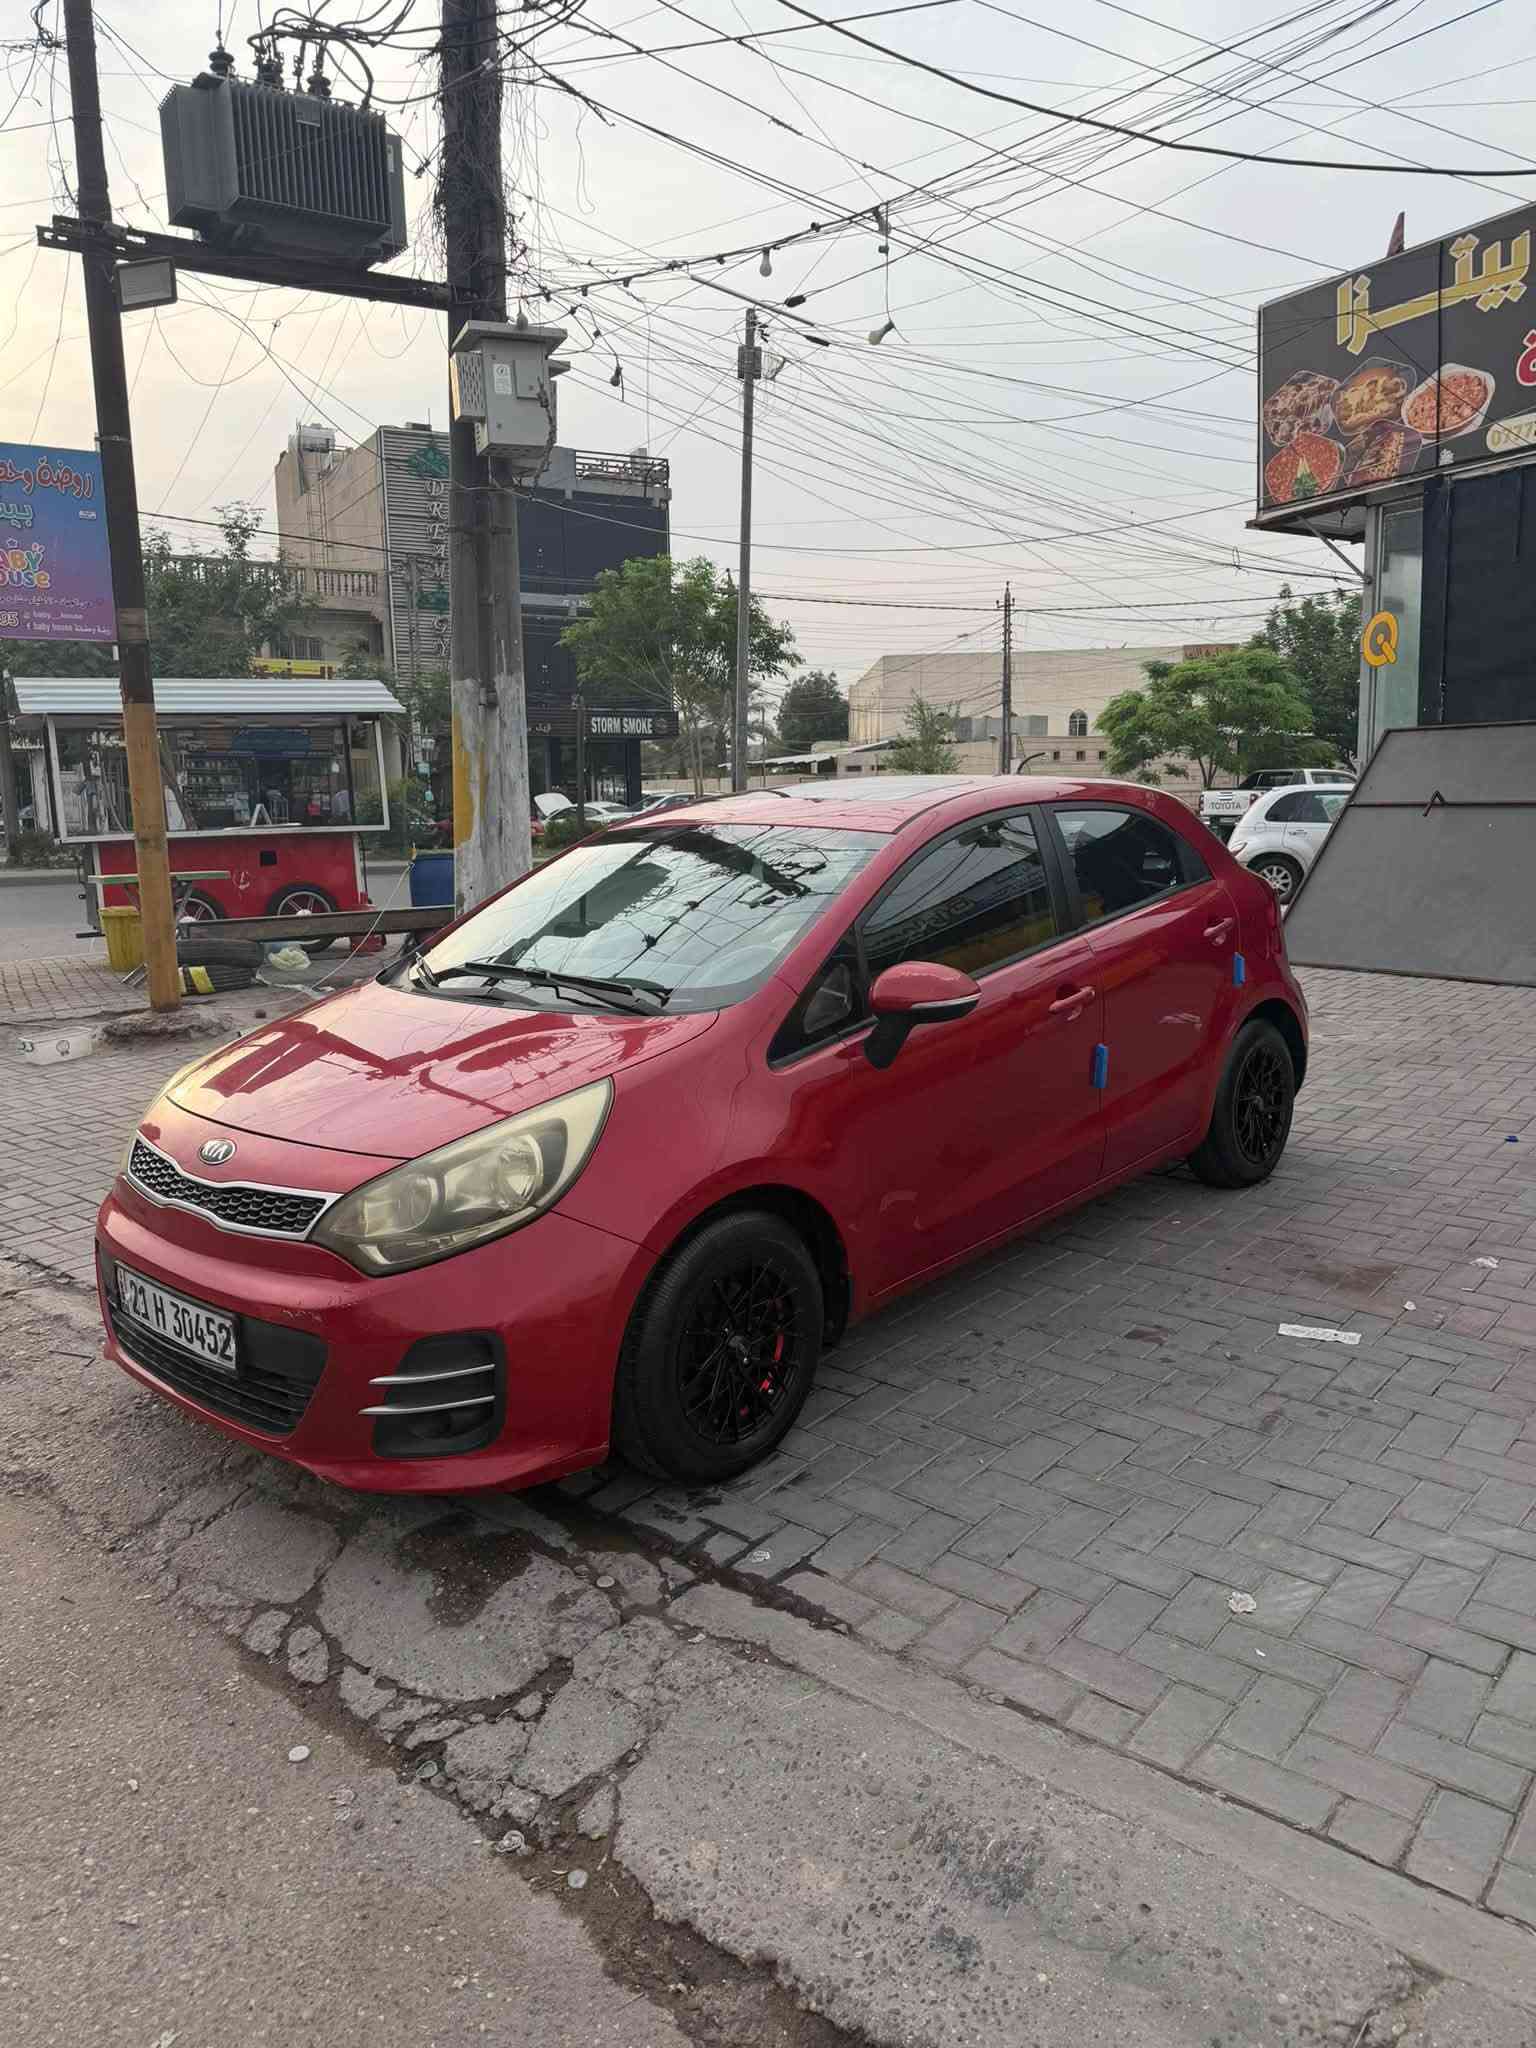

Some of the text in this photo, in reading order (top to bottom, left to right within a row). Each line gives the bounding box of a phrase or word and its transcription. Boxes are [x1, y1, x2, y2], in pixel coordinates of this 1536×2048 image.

[1337, 228, 1531, 356] بيتزا
[35, 455, 93, 497] روضة
[591, 716, 653, 734] STORM SMOKE
[1209, 801, 1241, 810] TOYOTA
[202, 1140, 228, 1160] KIA
[152, 1292, 167, 1330] H
[169, 1300, 234, 1362] 30452
